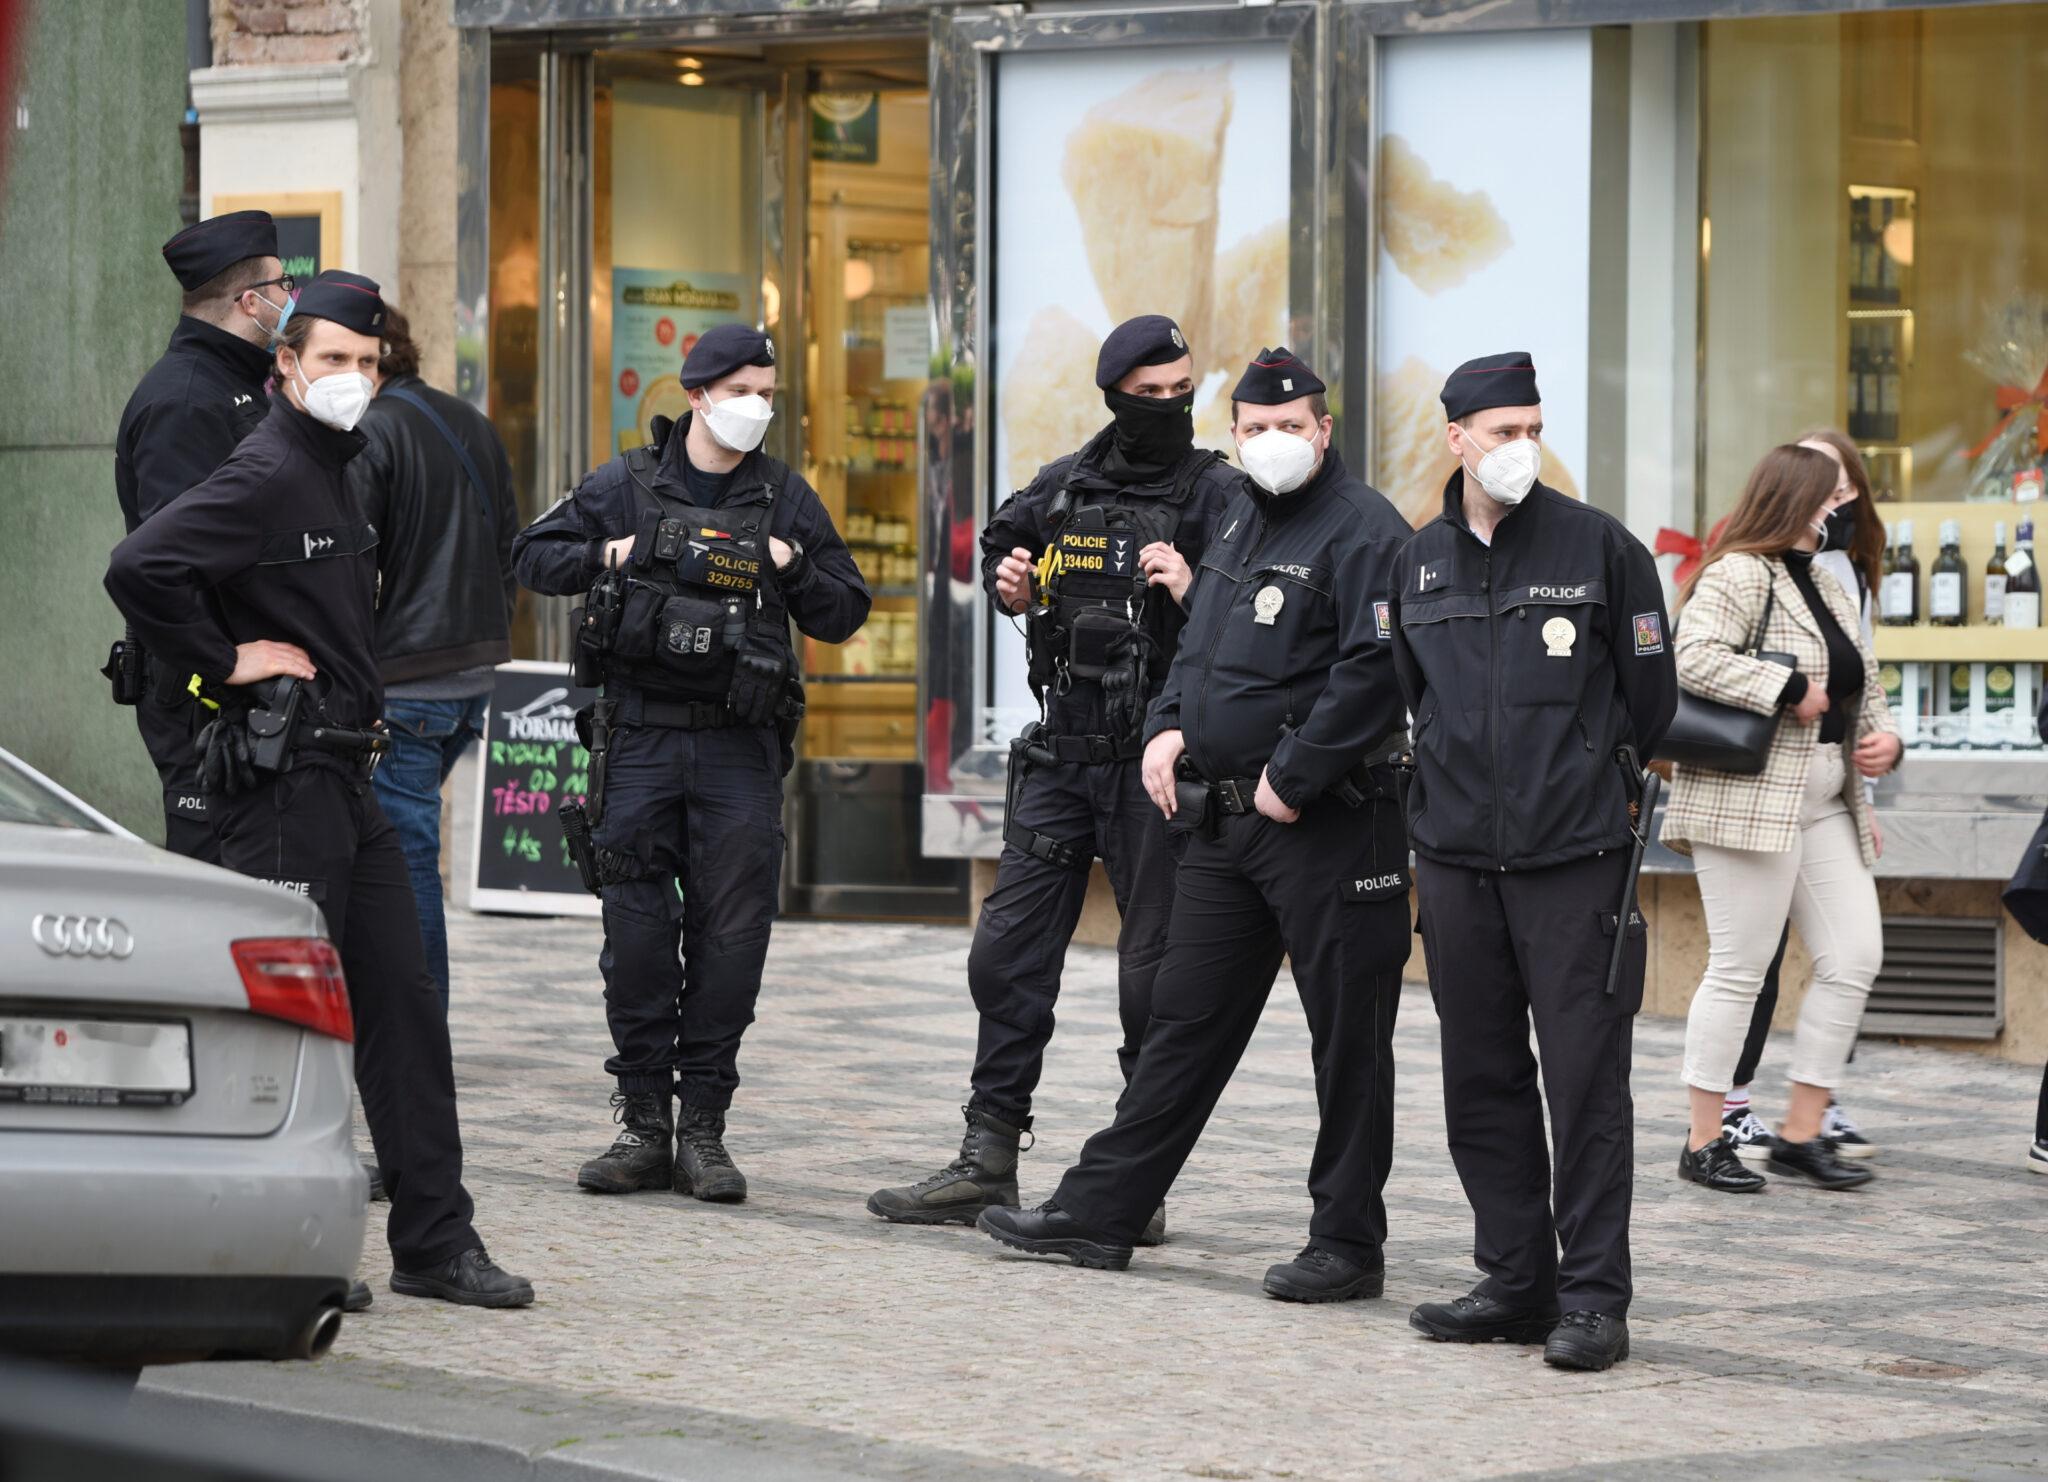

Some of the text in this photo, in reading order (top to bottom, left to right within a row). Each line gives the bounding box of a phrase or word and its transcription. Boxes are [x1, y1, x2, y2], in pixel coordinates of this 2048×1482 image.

[1062, 534, 1108, 549] POLICIE
[1064, 553, 1103, 570] 334460
[707, 571, 754, 590] 329755
[1272, 564, 1312, 580] LICIE
[1529, 585, 1587, 599] POLICIE
[1638, 644, 1661, 653] POLICIE
[528, 768, 558, 793] OD
[491, 778, 551, 817] TĚSTO
[1354, 873, 1402, 893] POLICIE
